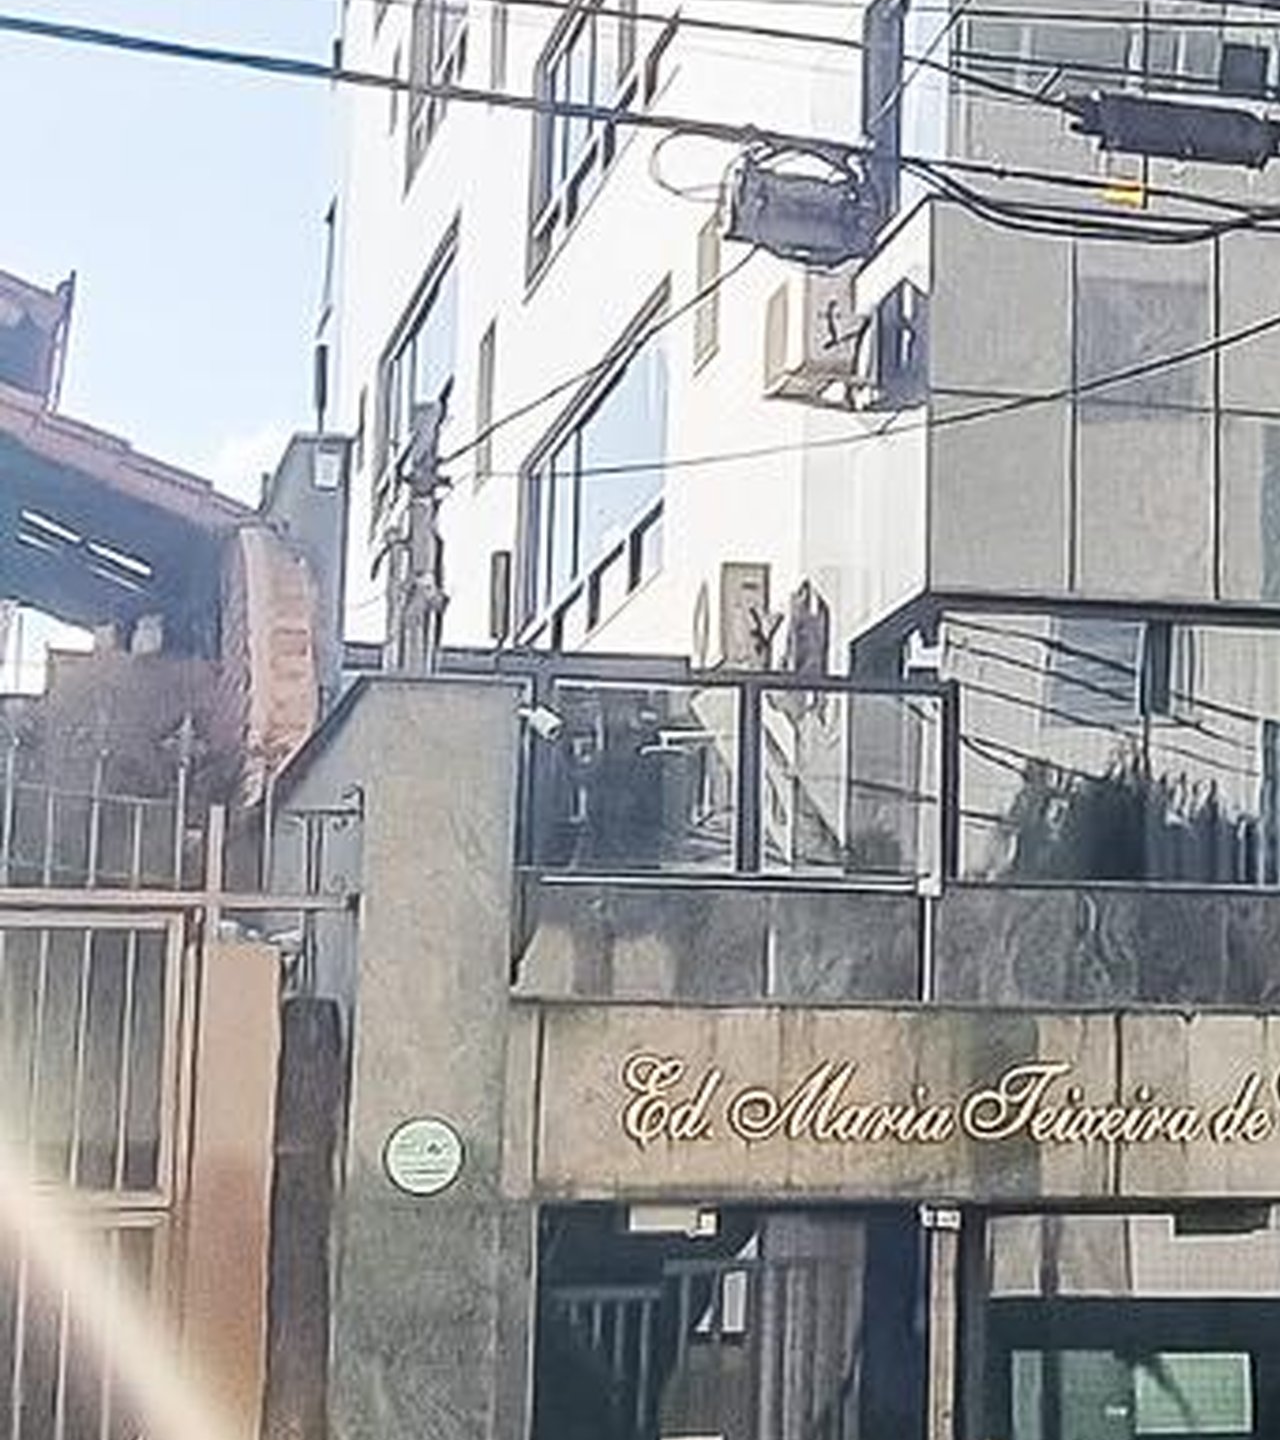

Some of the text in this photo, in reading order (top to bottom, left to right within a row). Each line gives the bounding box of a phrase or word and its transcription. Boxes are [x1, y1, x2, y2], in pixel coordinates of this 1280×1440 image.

[622, 1051, 721, 1146] Ed.
[728, 1059, 954, 1141] Maria
[961, 1061, 1202, 1141] Teixeira
[1211, 1073, 1273, 1142] de
